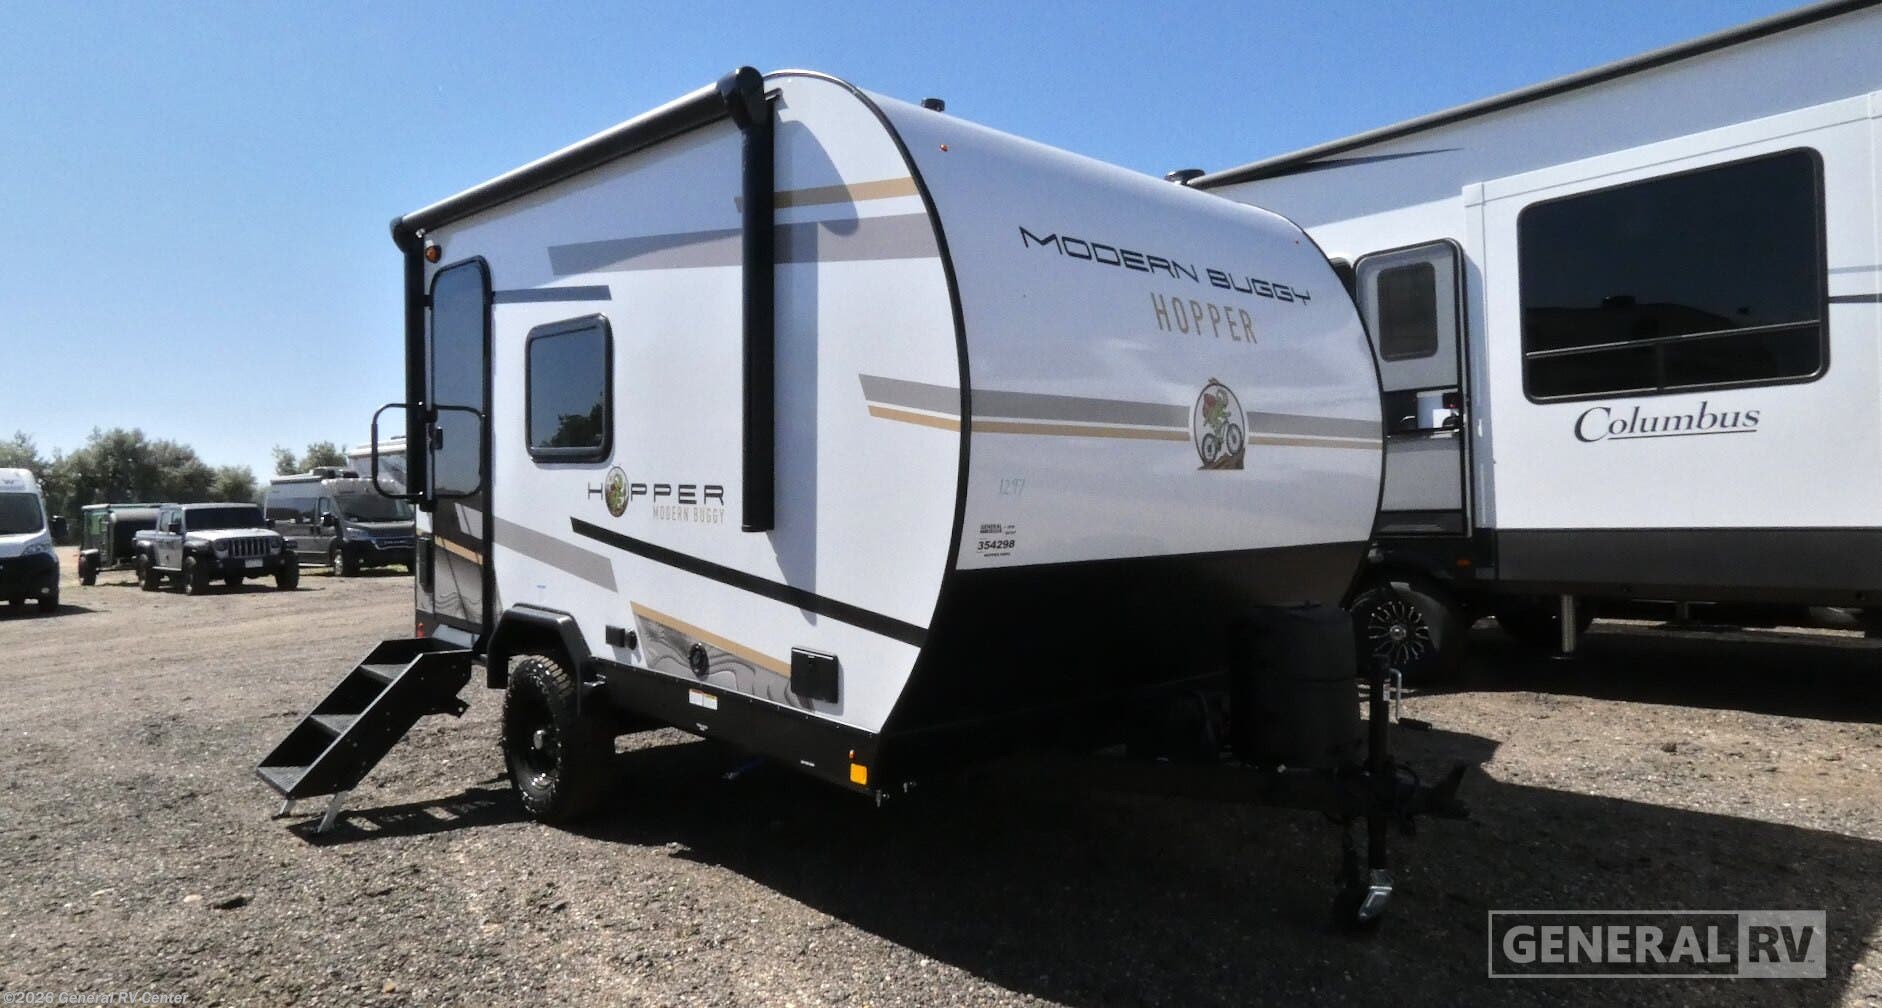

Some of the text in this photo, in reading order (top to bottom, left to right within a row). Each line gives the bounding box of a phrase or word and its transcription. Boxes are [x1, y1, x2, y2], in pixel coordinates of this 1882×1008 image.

[1019, 226, 1311, 306] MODERN BUGGY
[1150, 292, 1258, 344] HOPPER
[1574, 401, 1760, 443] Columbus
[653, 506, 725, 524] MODERN BUGGY
[977, 540, 1015, 550] 354298
